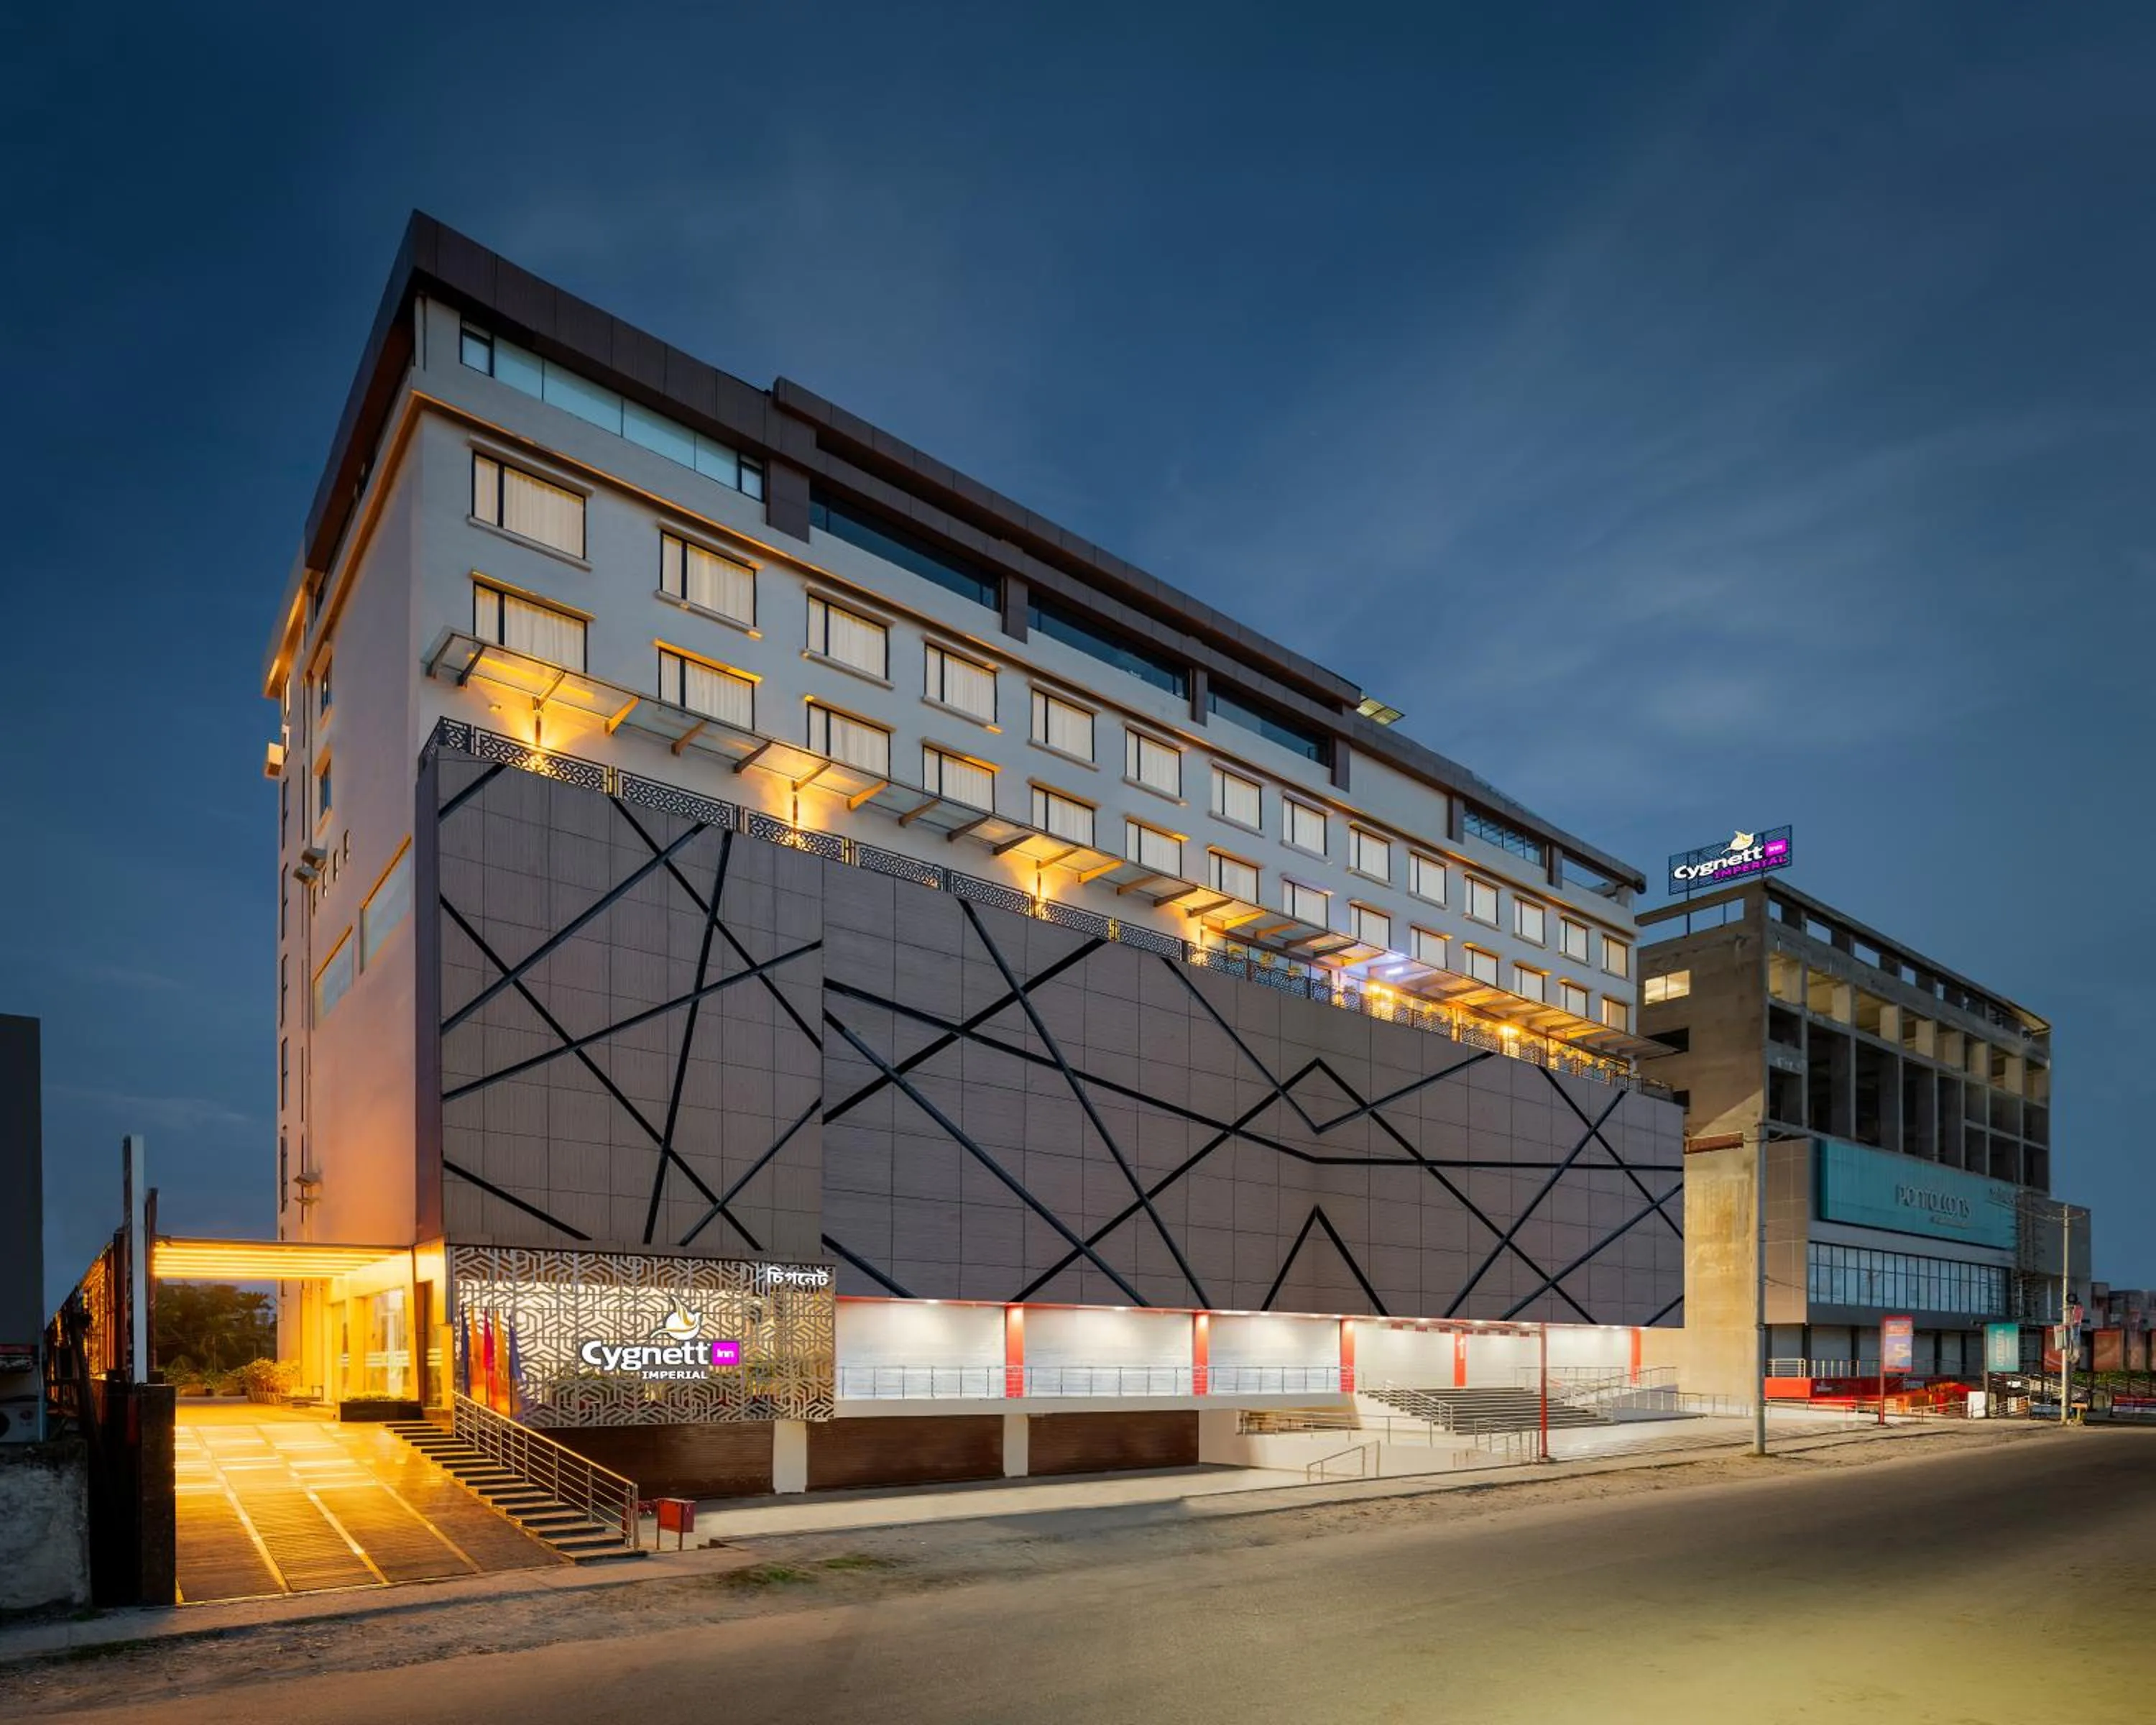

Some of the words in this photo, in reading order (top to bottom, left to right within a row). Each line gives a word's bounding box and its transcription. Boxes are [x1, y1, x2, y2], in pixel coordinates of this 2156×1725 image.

[1674, 845, 1764, 879] Cygnett
[1713, 855, 1788, 879] IMPERIAL
[581, 1340, 710, 1371] Cygnett
[641, 1371, 708, 1380] IMPERIAL
